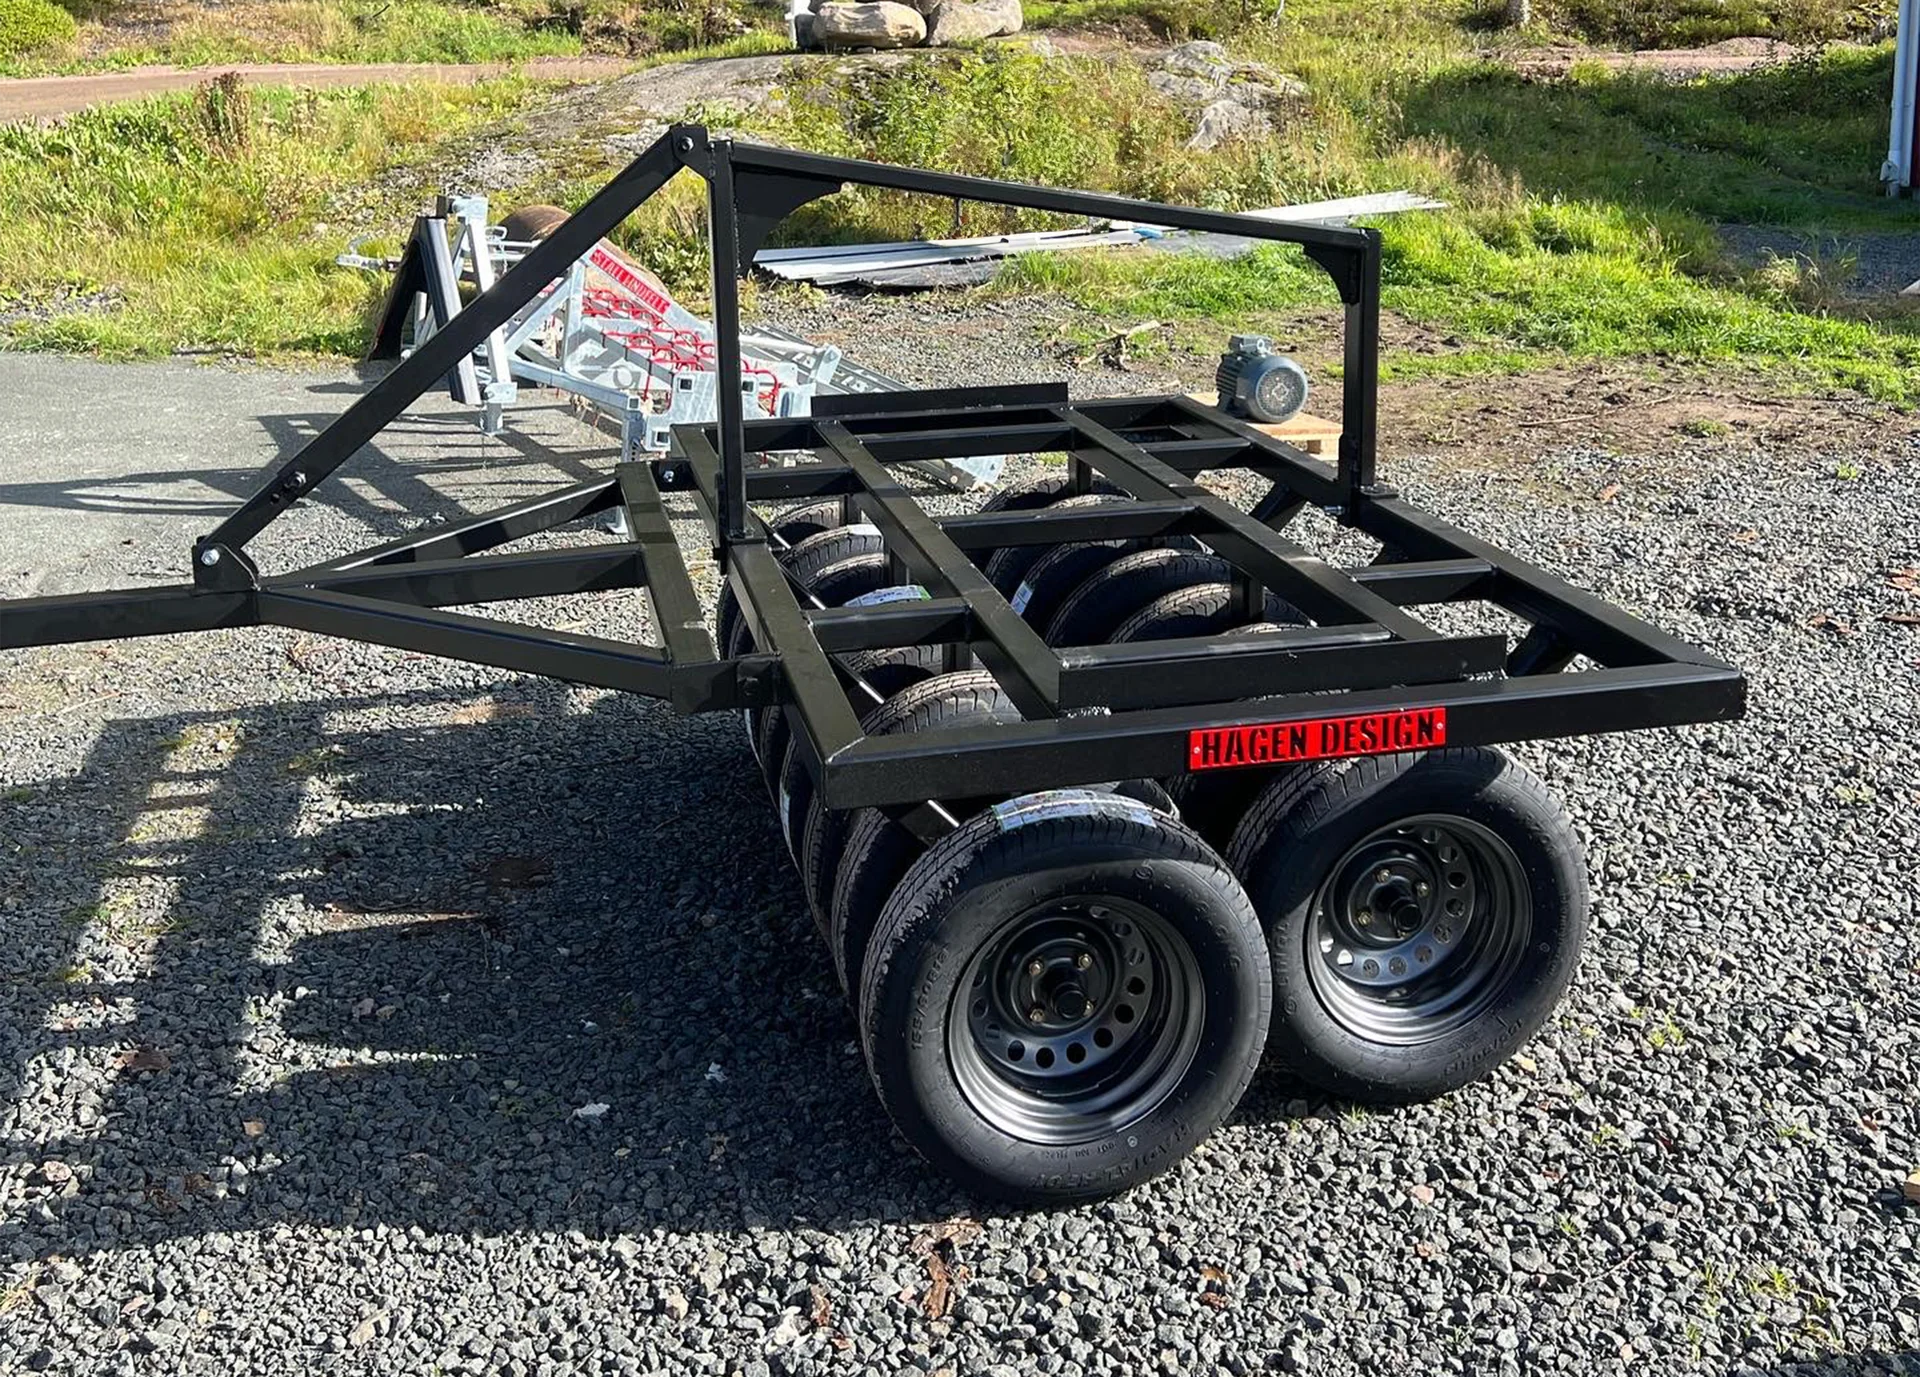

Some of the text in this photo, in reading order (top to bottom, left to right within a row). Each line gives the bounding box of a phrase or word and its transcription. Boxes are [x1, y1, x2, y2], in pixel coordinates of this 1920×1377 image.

[592, 251, 626, 281] STALL
[1201, 711, 1435, 766] HAGEN DESIGN
